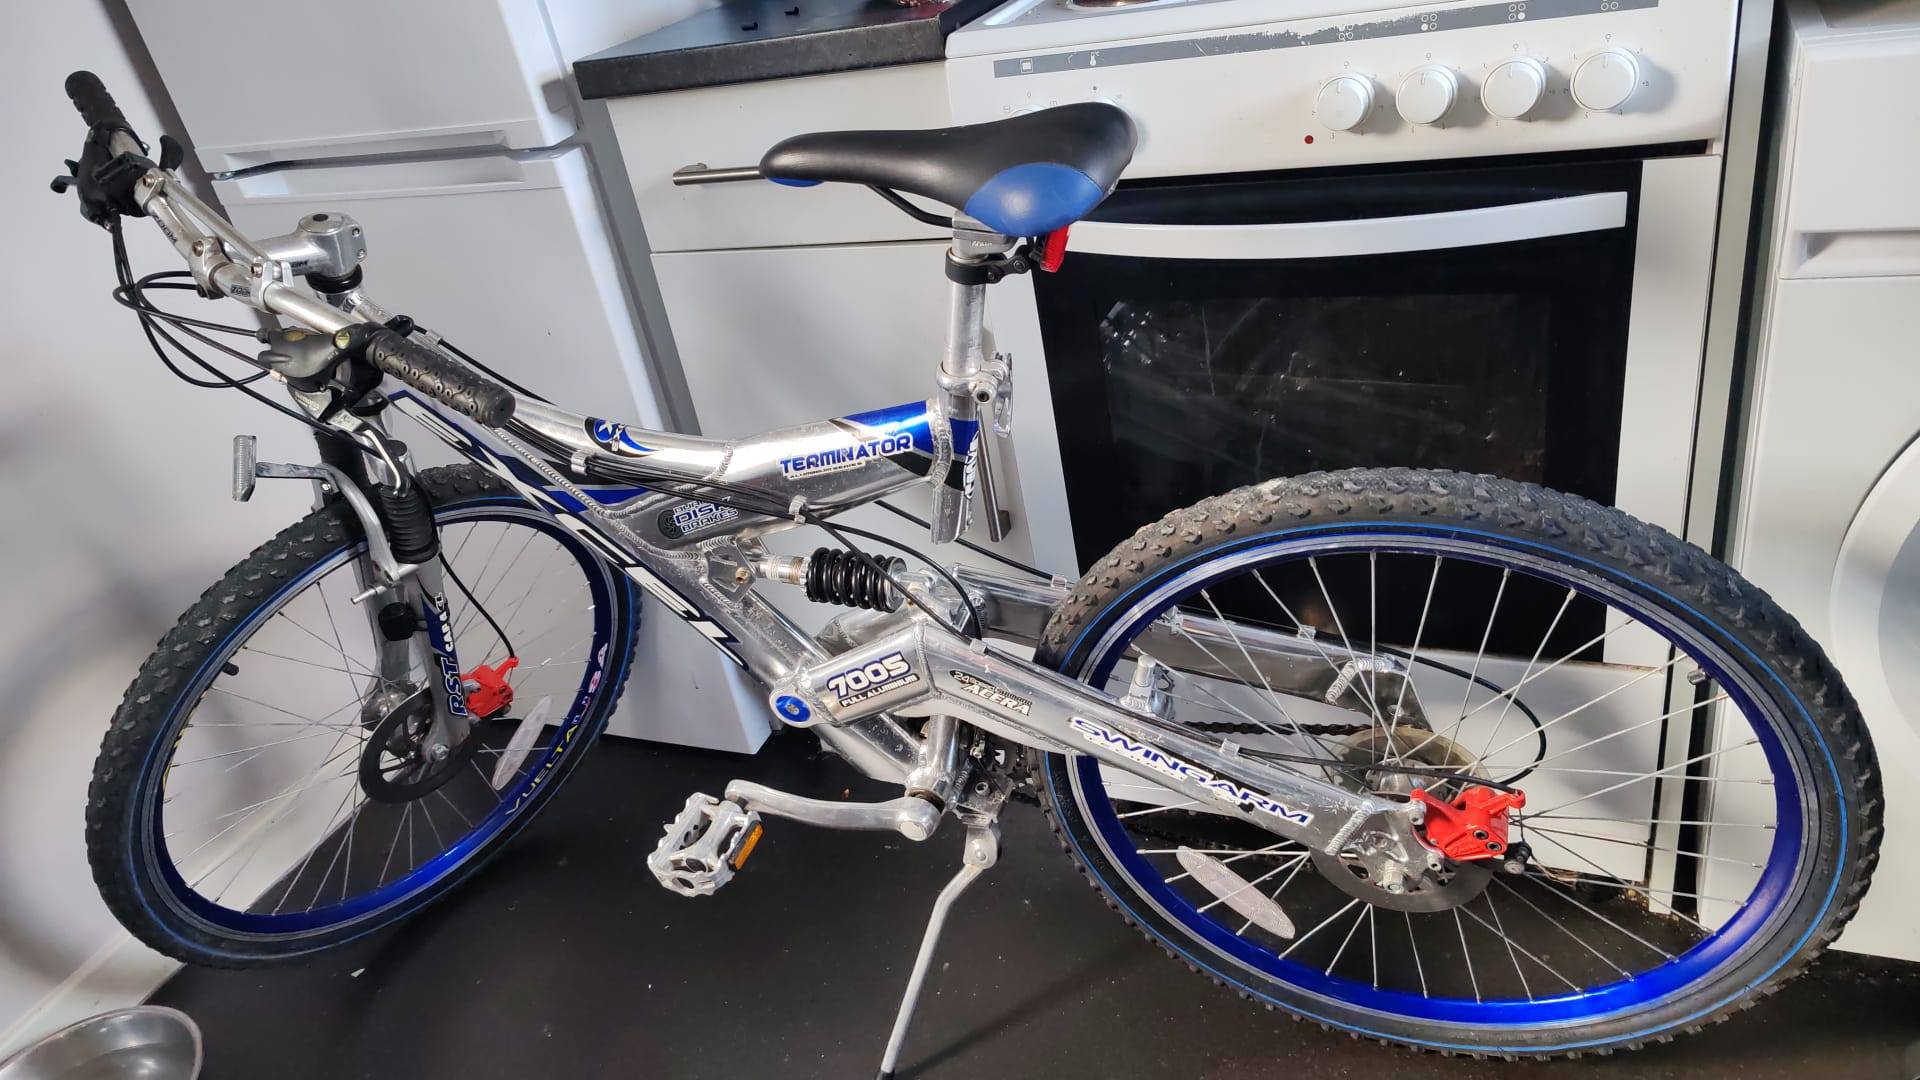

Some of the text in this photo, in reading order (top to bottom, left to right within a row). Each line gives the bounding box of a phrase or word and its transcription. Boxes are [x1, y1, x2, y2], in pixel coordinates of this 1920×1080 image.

[780, 433, 911, 474] TERMINATOR
[393, 395, 747, 668] EXCEL
[681, 508, 740, 533] BRAKES
[440, 656, 469, 717] RST
[826, 650, 911, 699] 7005
[841, 674, 918, 708] FULL ALUMINIUM
[953, 671, 970, 684] 24
[961, 684, 1032, 716] ACERA
[505, 724, 578, 815] VUELTA
[1074, 717, 1310, 825] SWINGARM
